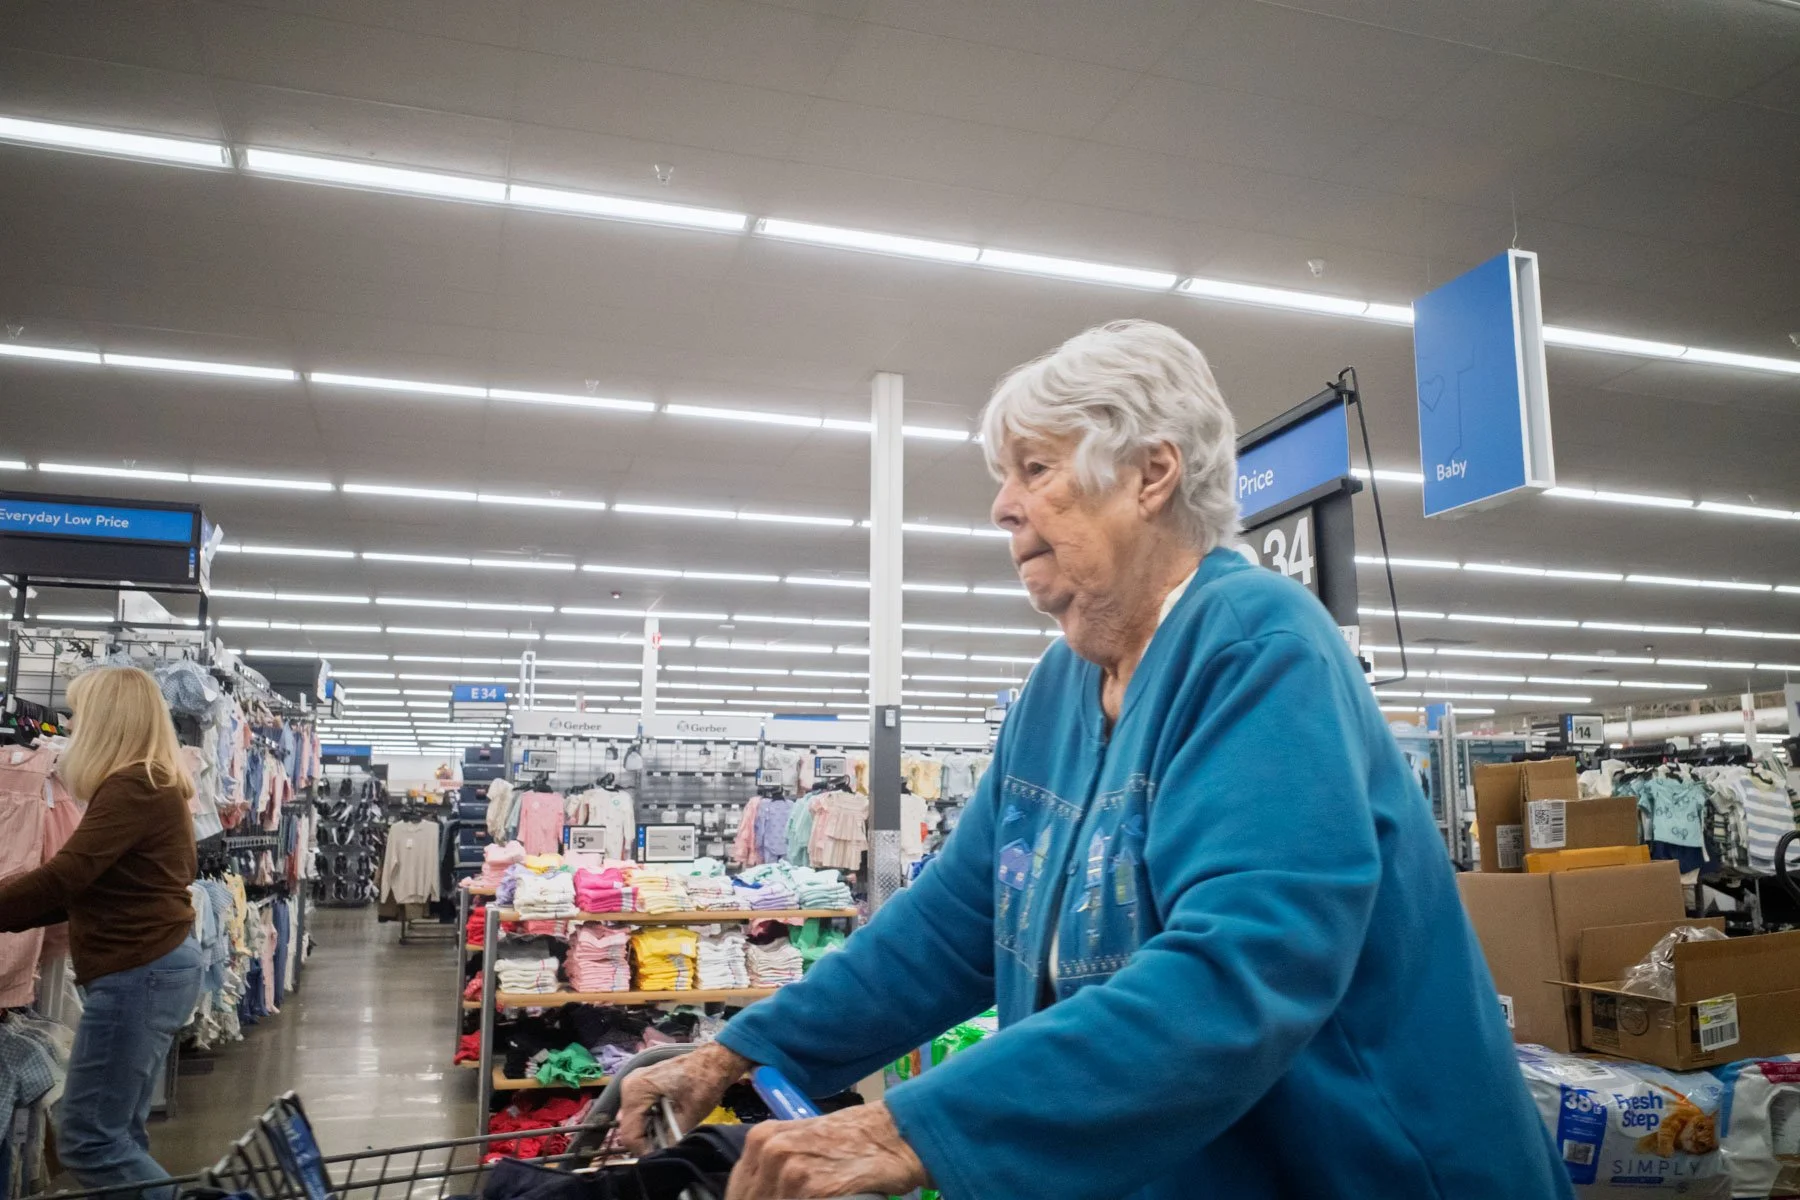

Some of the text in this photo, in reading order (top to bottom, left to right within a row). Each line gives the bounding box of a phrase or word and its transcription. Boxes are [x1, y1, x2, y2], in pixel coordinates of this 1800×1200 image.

[1436, 460, 1467, 482] Baby
[1238, 468, 1274, 499] Price
[0, 508, 129, 528] Everyday Low Price
[471, 688, 497, 699] E 34
[563, 720, 602, 731] Gerber
[690, 723, 727, 732] Gerber
[1612, 1090, 1664, 1110] Fresh
[1622, 1110, 1660, 1131] Step
[1611, 1159, 1700, 1176] SIMPLY
